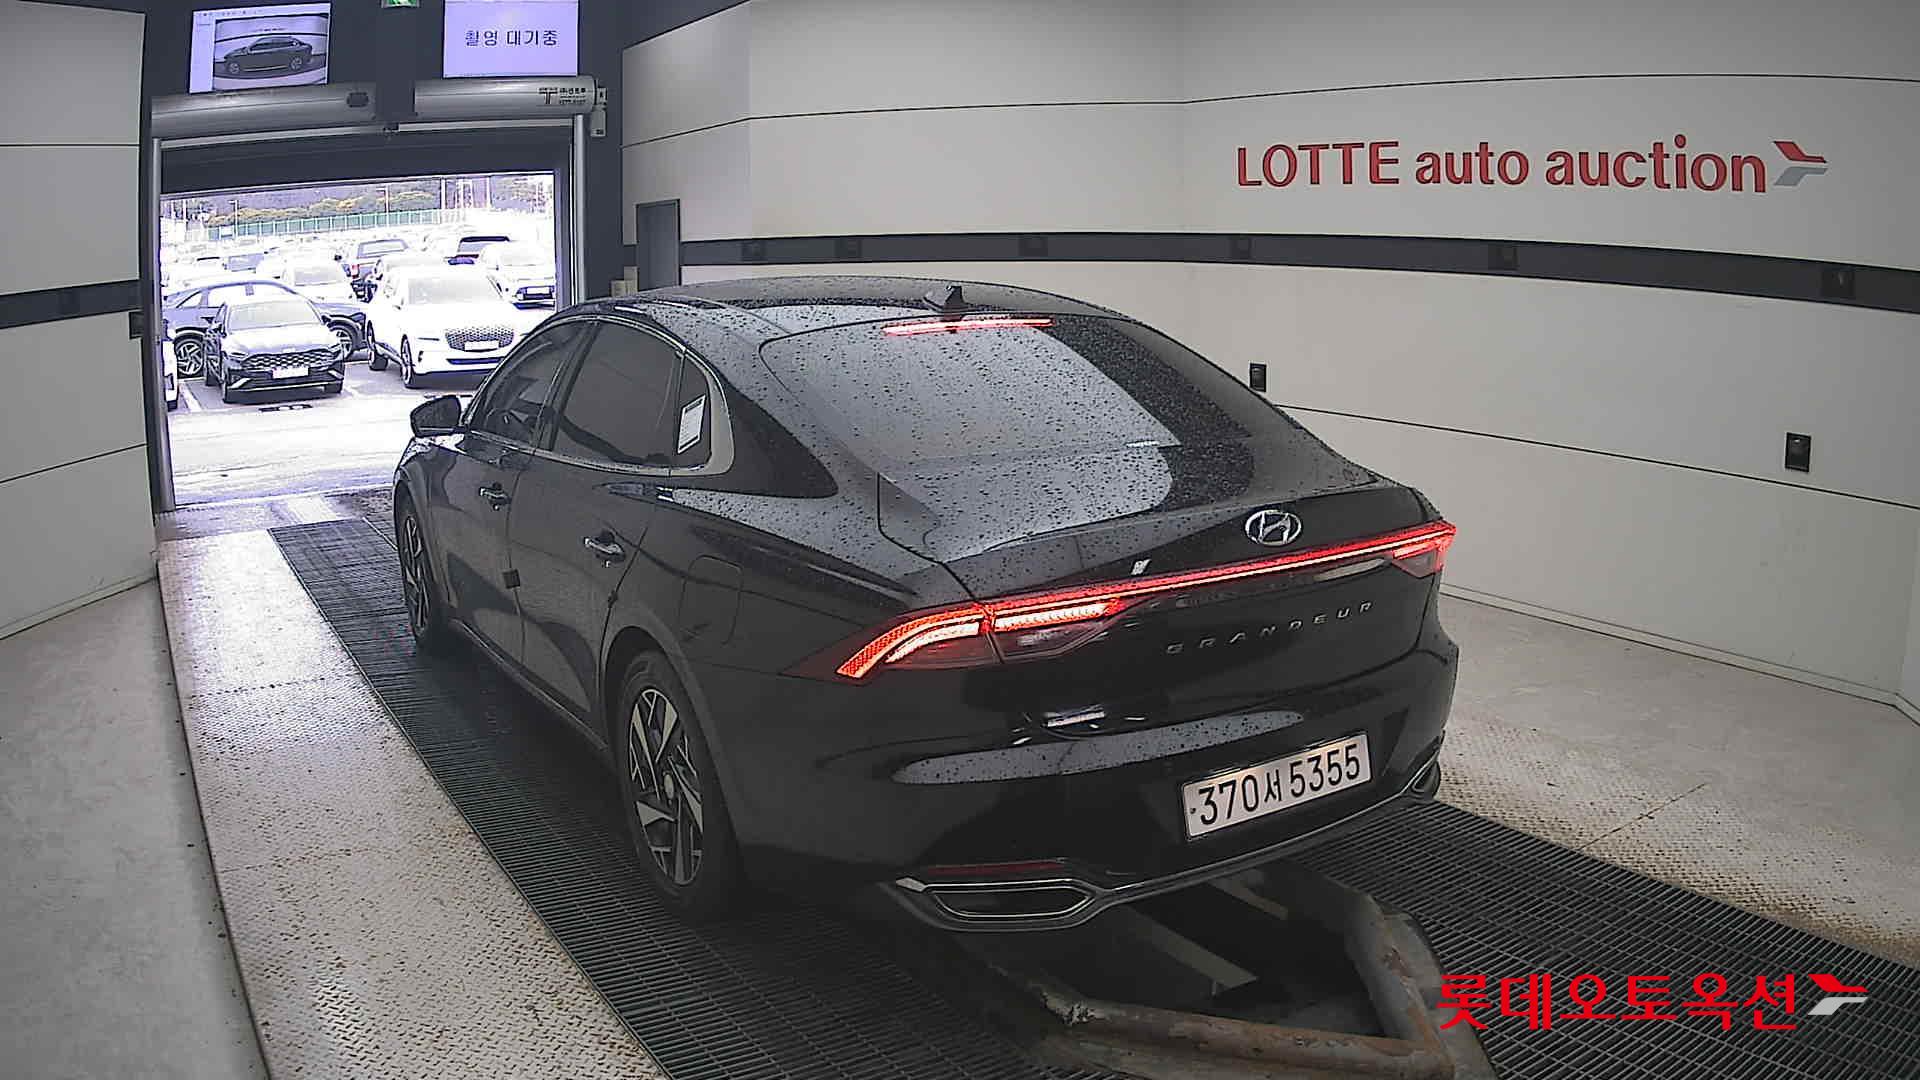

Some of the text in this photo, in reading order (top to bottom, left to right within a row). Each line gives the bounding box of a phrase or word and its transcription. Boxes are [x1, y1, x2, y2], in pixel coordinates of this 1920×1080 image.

[506, 30, 558, 46] 대기중
[1237, 134, 1766, 193] LOTTE auto auction
[1166, 600, 1373, 654] GRANDEUR
[1289, 743, 1360, 798] 5355
